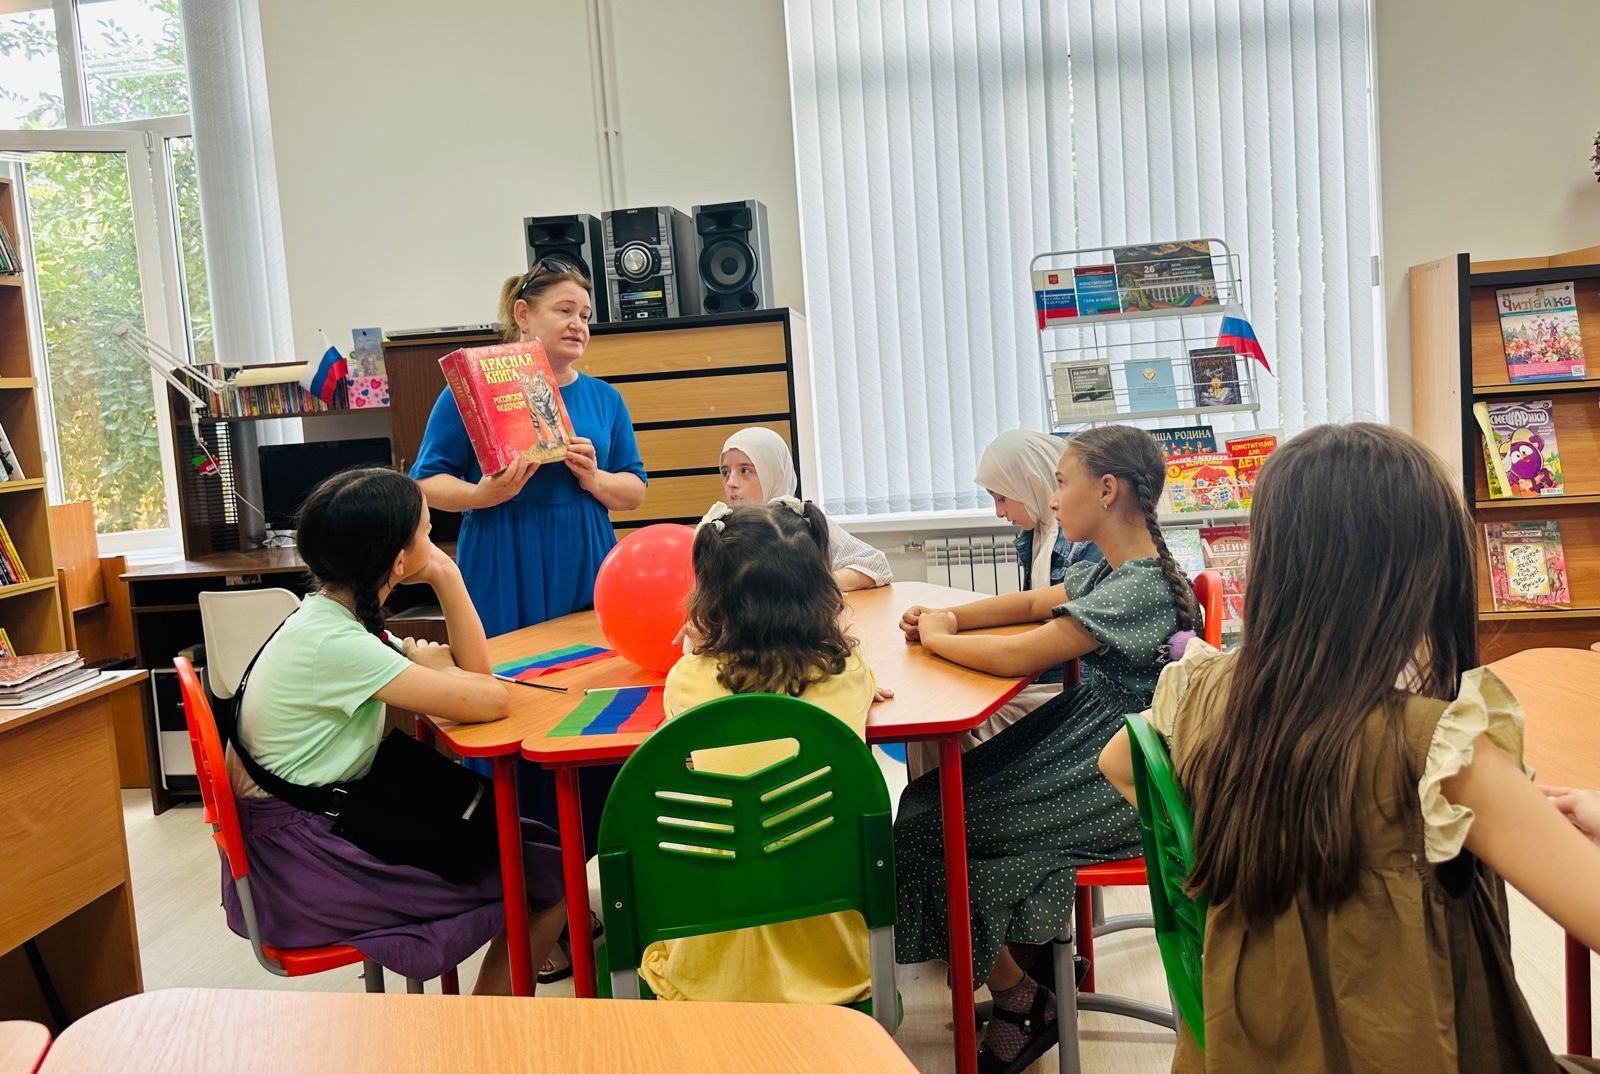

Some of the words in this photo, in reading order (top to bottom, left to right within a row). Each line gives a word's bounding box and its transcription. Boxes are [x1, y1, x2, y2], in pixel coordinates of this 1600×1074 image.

[1144, 265, 1156, 274] 26
[1502, 294, 1572, 312] Читайка
[480, 353, 534, 372] КРАСНАЯ
[484, 368, 520, 385] КНИГА
[1490, 410, 1546, 426] СМЕШАРИКИ
[1151, 432, 1172, 442] АША
[1174, 429, 1212, 440] РОДИНА
[1231, 440, 1274, 451] КОНСТИТУЦИЯ
[1237, 457, 1266, 469] ДЕТЕ
